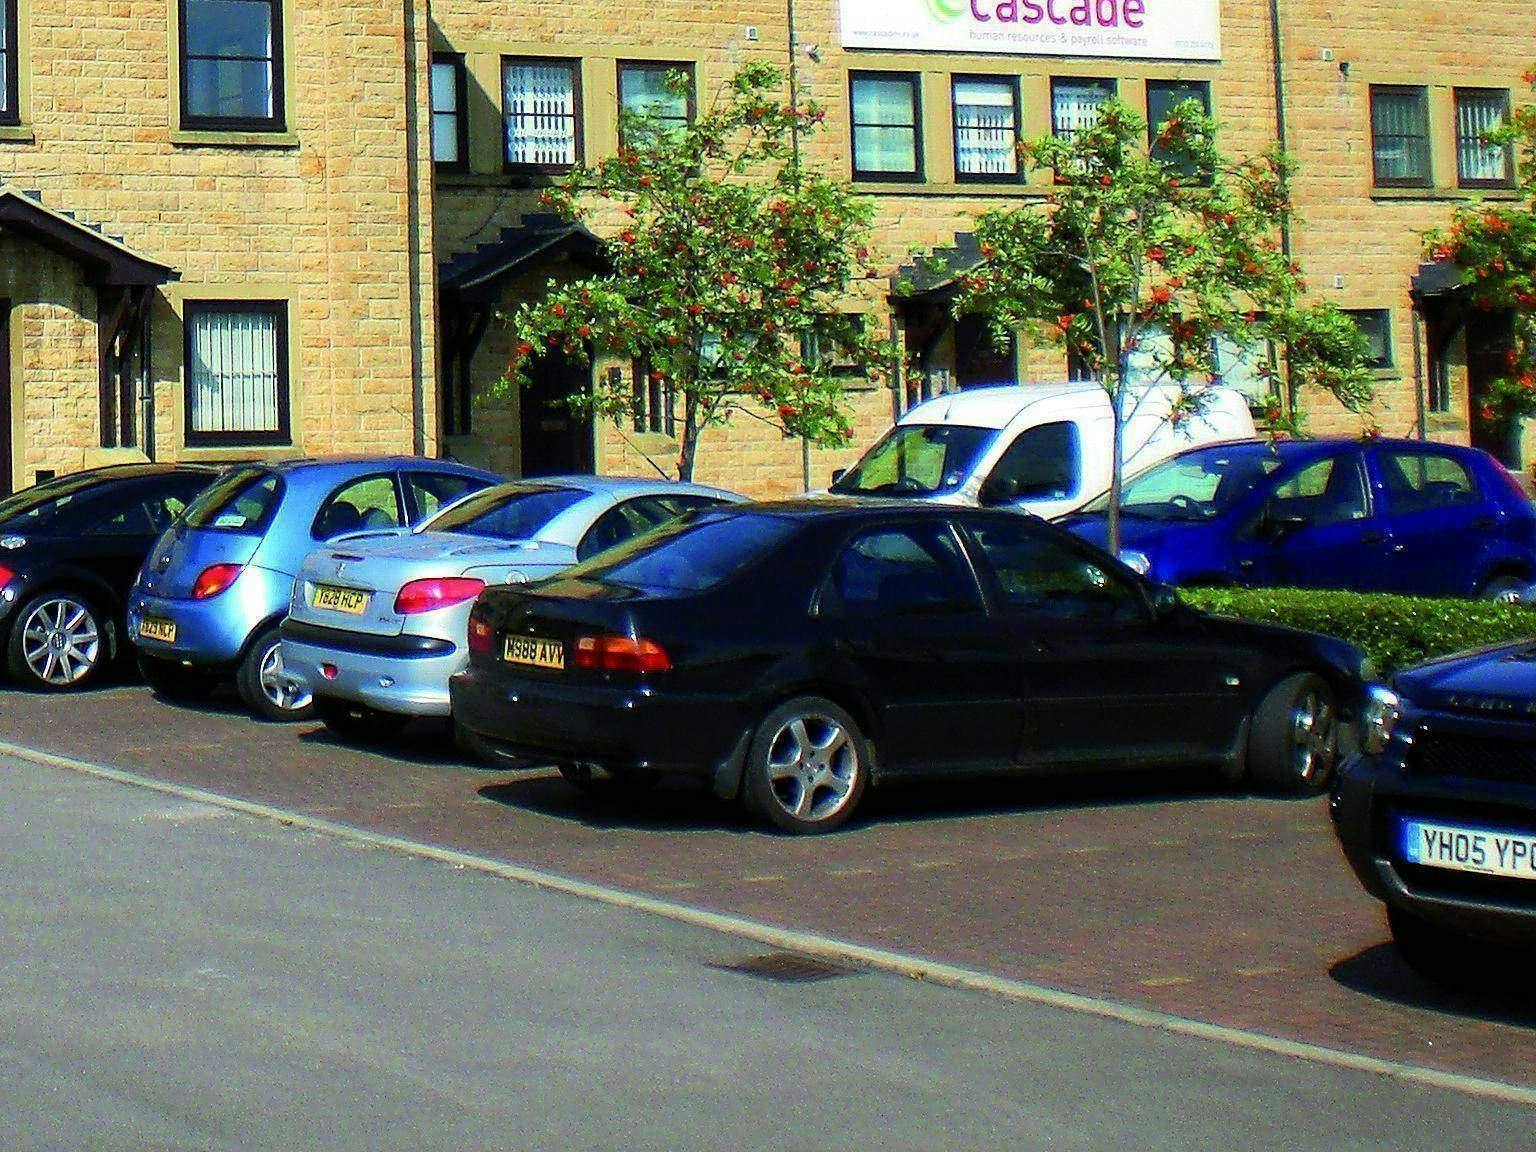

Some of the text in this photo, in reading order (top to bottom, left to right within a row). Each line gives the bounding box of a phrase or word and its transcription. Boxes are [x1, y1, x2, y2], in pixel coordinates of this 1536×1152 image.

[969, 30, 1147, 48] human resources & payroll software
[1423, 829, 1486, 865] YH05
